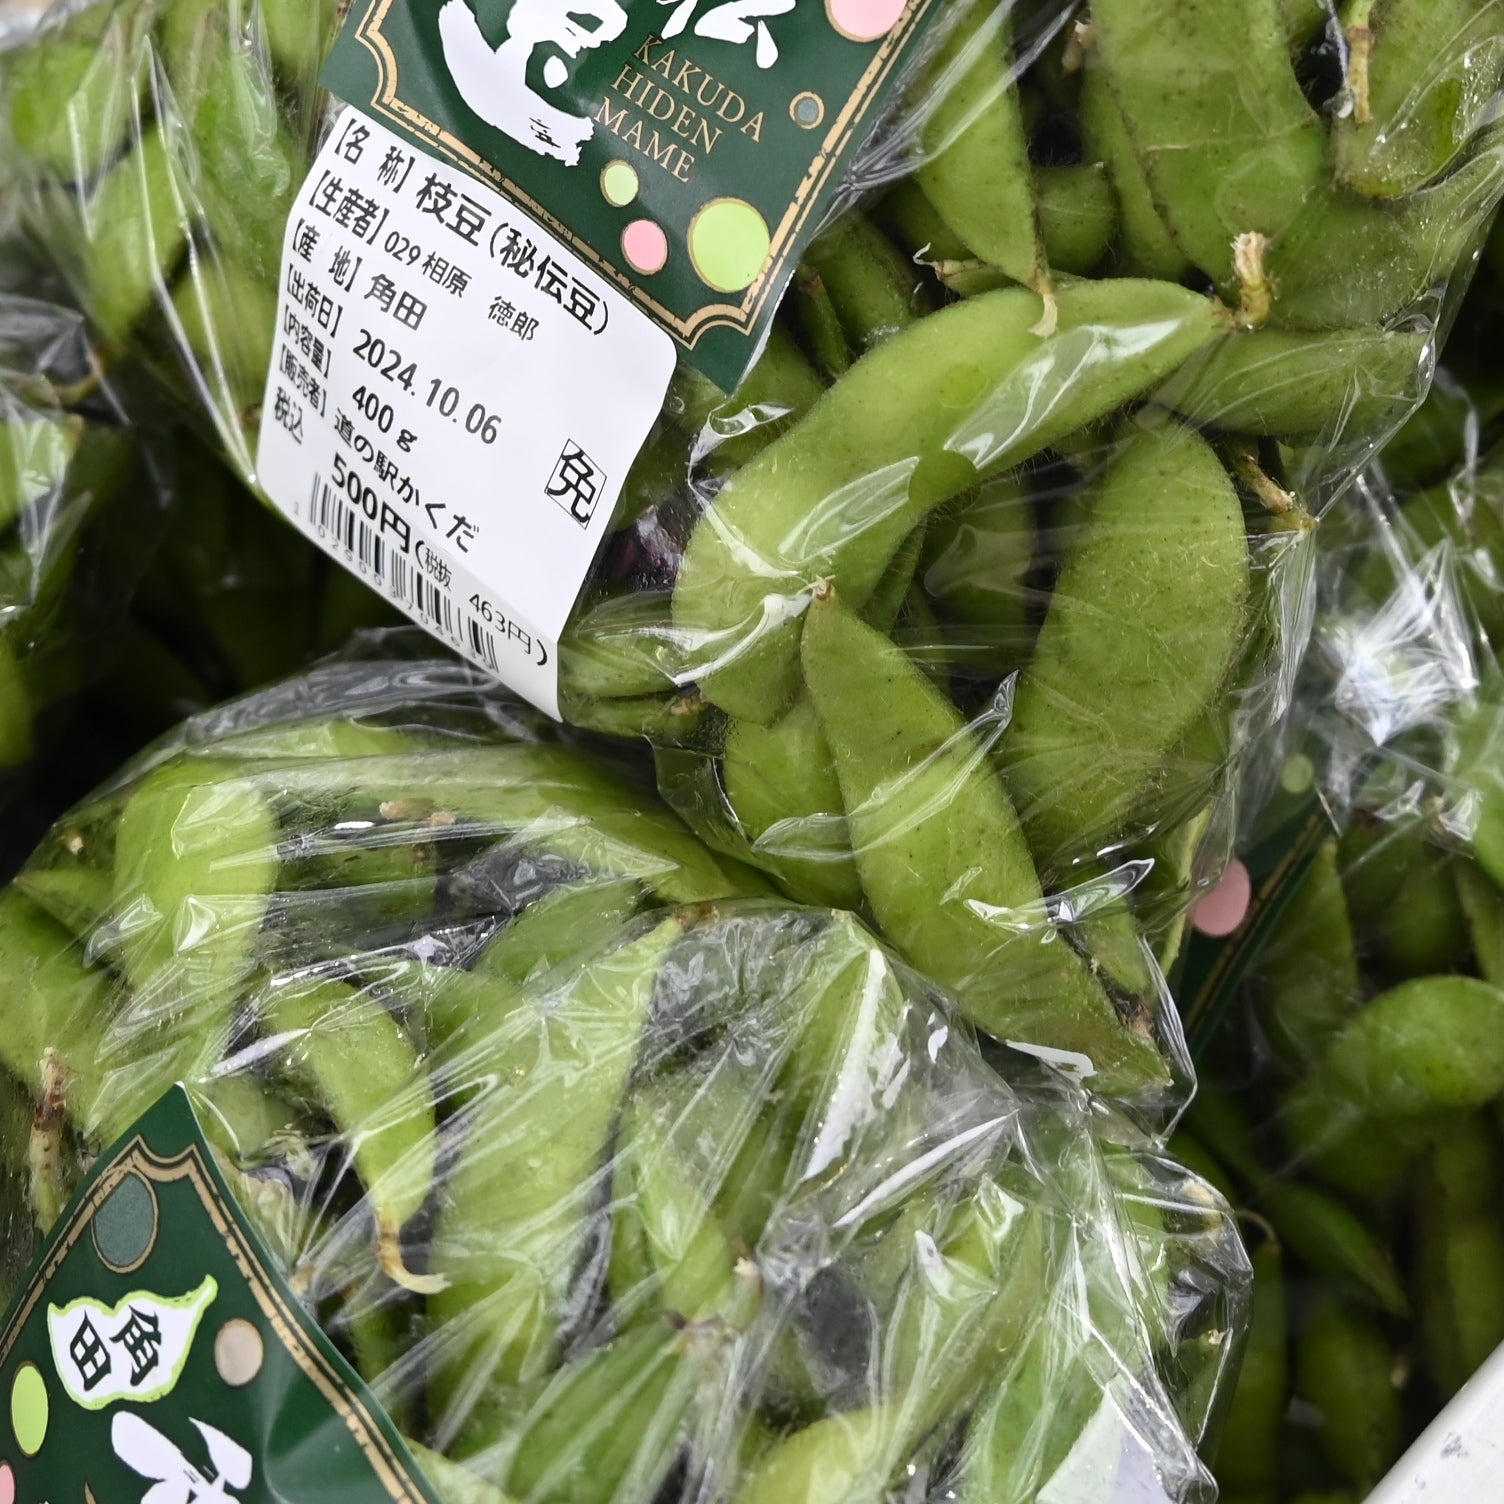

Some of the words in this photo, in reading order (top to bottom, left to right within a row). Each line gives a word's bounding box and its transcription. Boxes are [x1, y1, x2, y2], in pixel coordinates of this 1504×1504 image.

[610, 63, 723, 155] HIDEN
[633, 34, 764, 144] KAKUDA
[593, 96, 696, 183] MAME
[363, 273, 428, 331] 角田
[274, 385, 304, 445] 税込
[334, 407, 480, 554] 道の駅かくだ
[546, 445, 599, 526] 免
[69, 1304, 163, 1393] 角田
